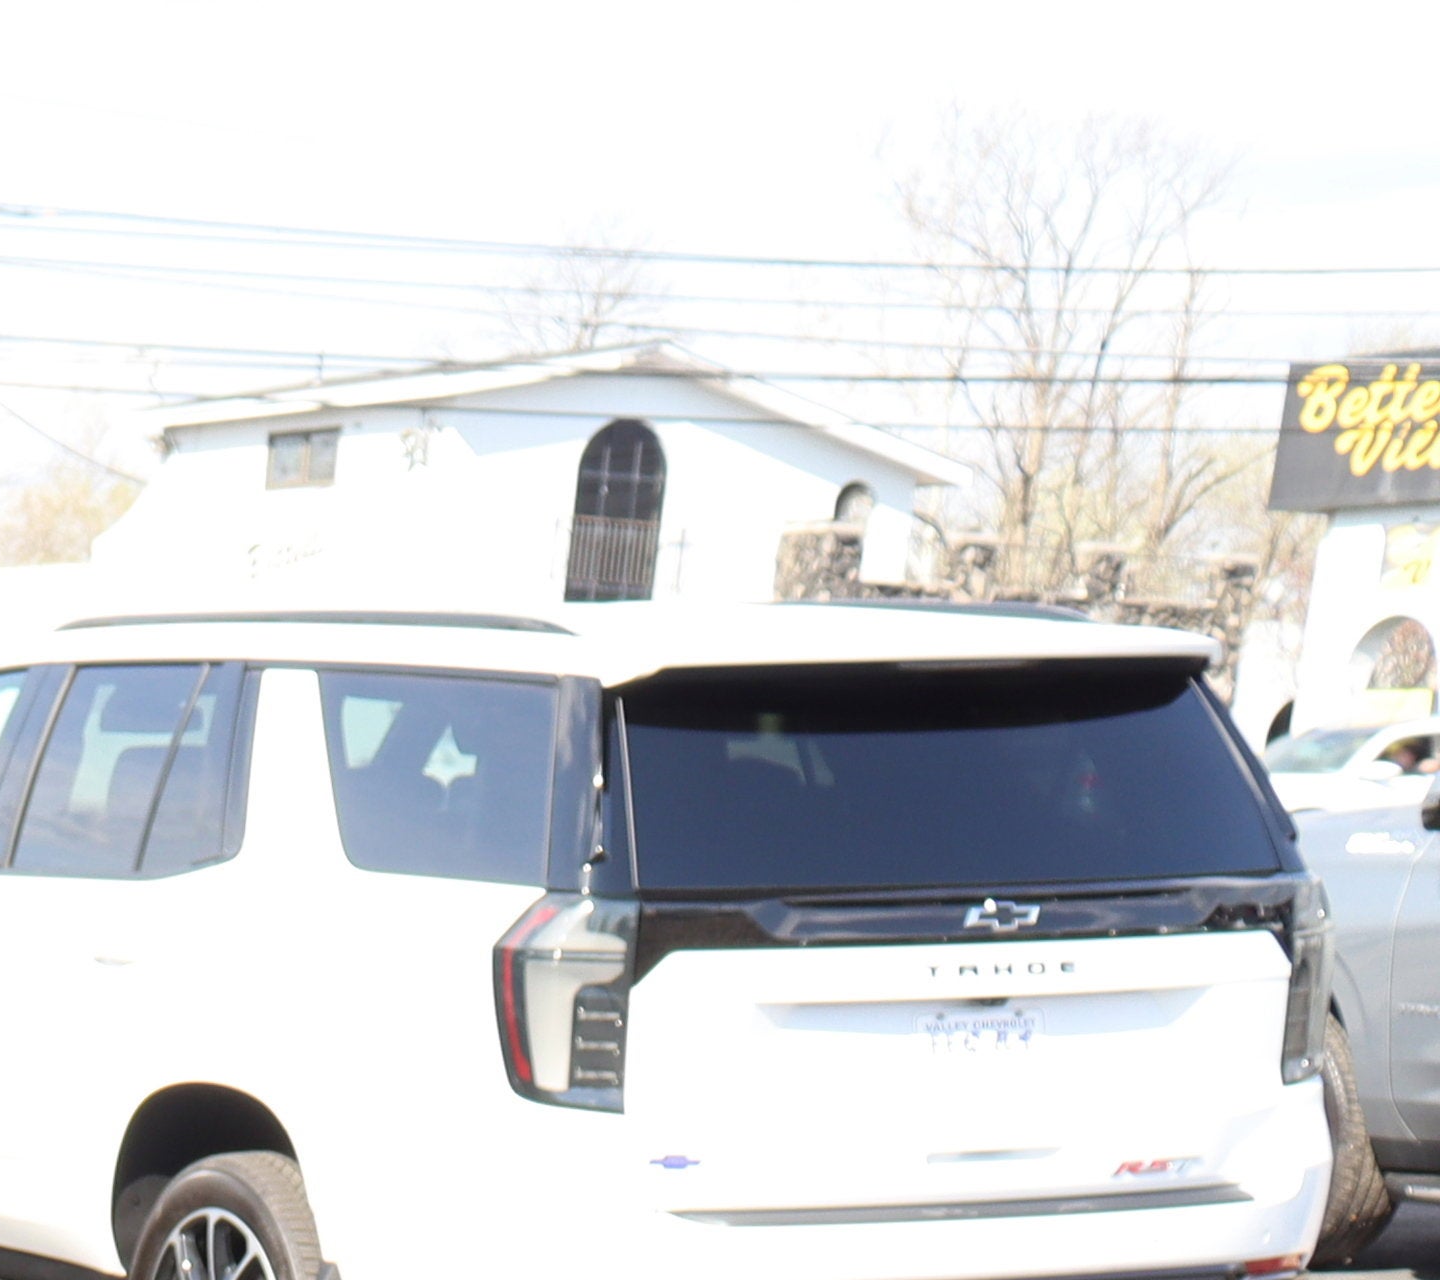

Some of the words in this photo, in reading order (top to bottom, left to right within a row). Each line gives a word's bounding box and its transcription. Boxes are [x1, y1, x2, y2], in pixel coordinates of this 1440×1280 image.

[929, 961, 1075, 978] TAHOE
[925, 1021, 970, 1033] VALLEY
[973, 1017, 1036, 1030] CHEVROLET
